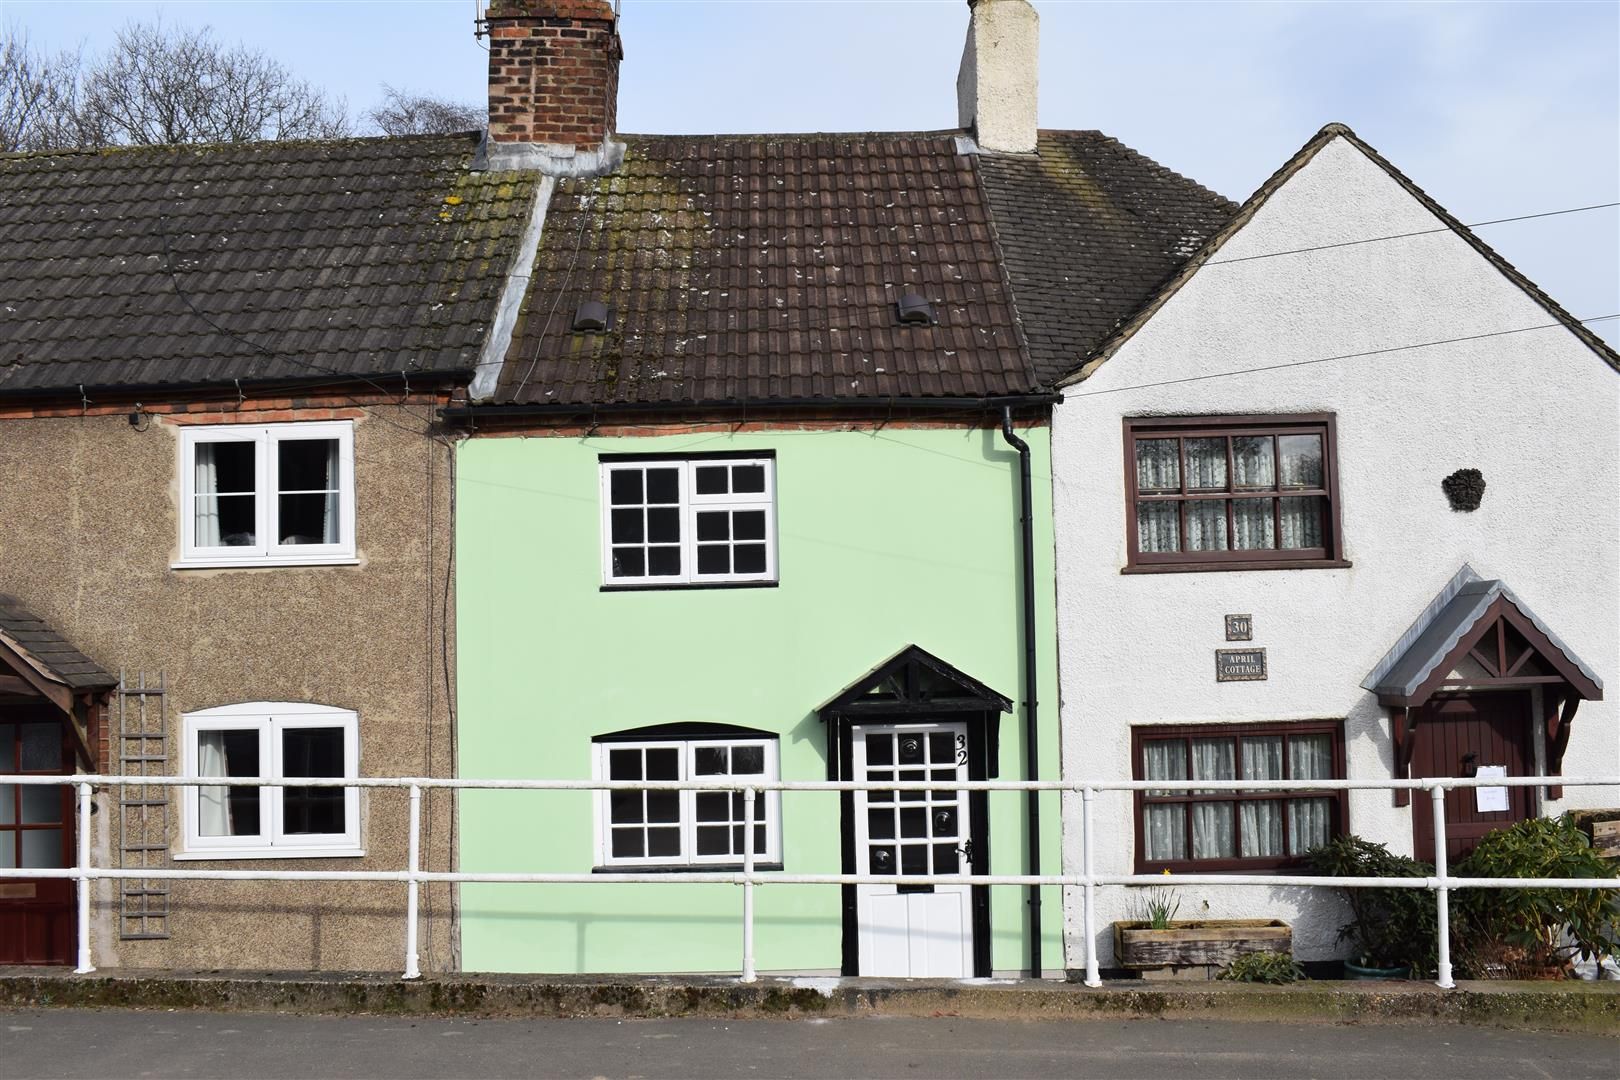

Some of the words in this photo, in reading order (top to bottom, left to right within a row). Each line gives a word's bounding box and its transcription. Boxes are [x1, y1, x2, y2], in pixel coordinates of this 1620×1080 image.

[1232, 621, 1248, 633] 30
[1229, 655, 1256, 664] APRIL
[1224, 665, 1261, 674] COTTAGE
[956, 734, 968, 767] 32
